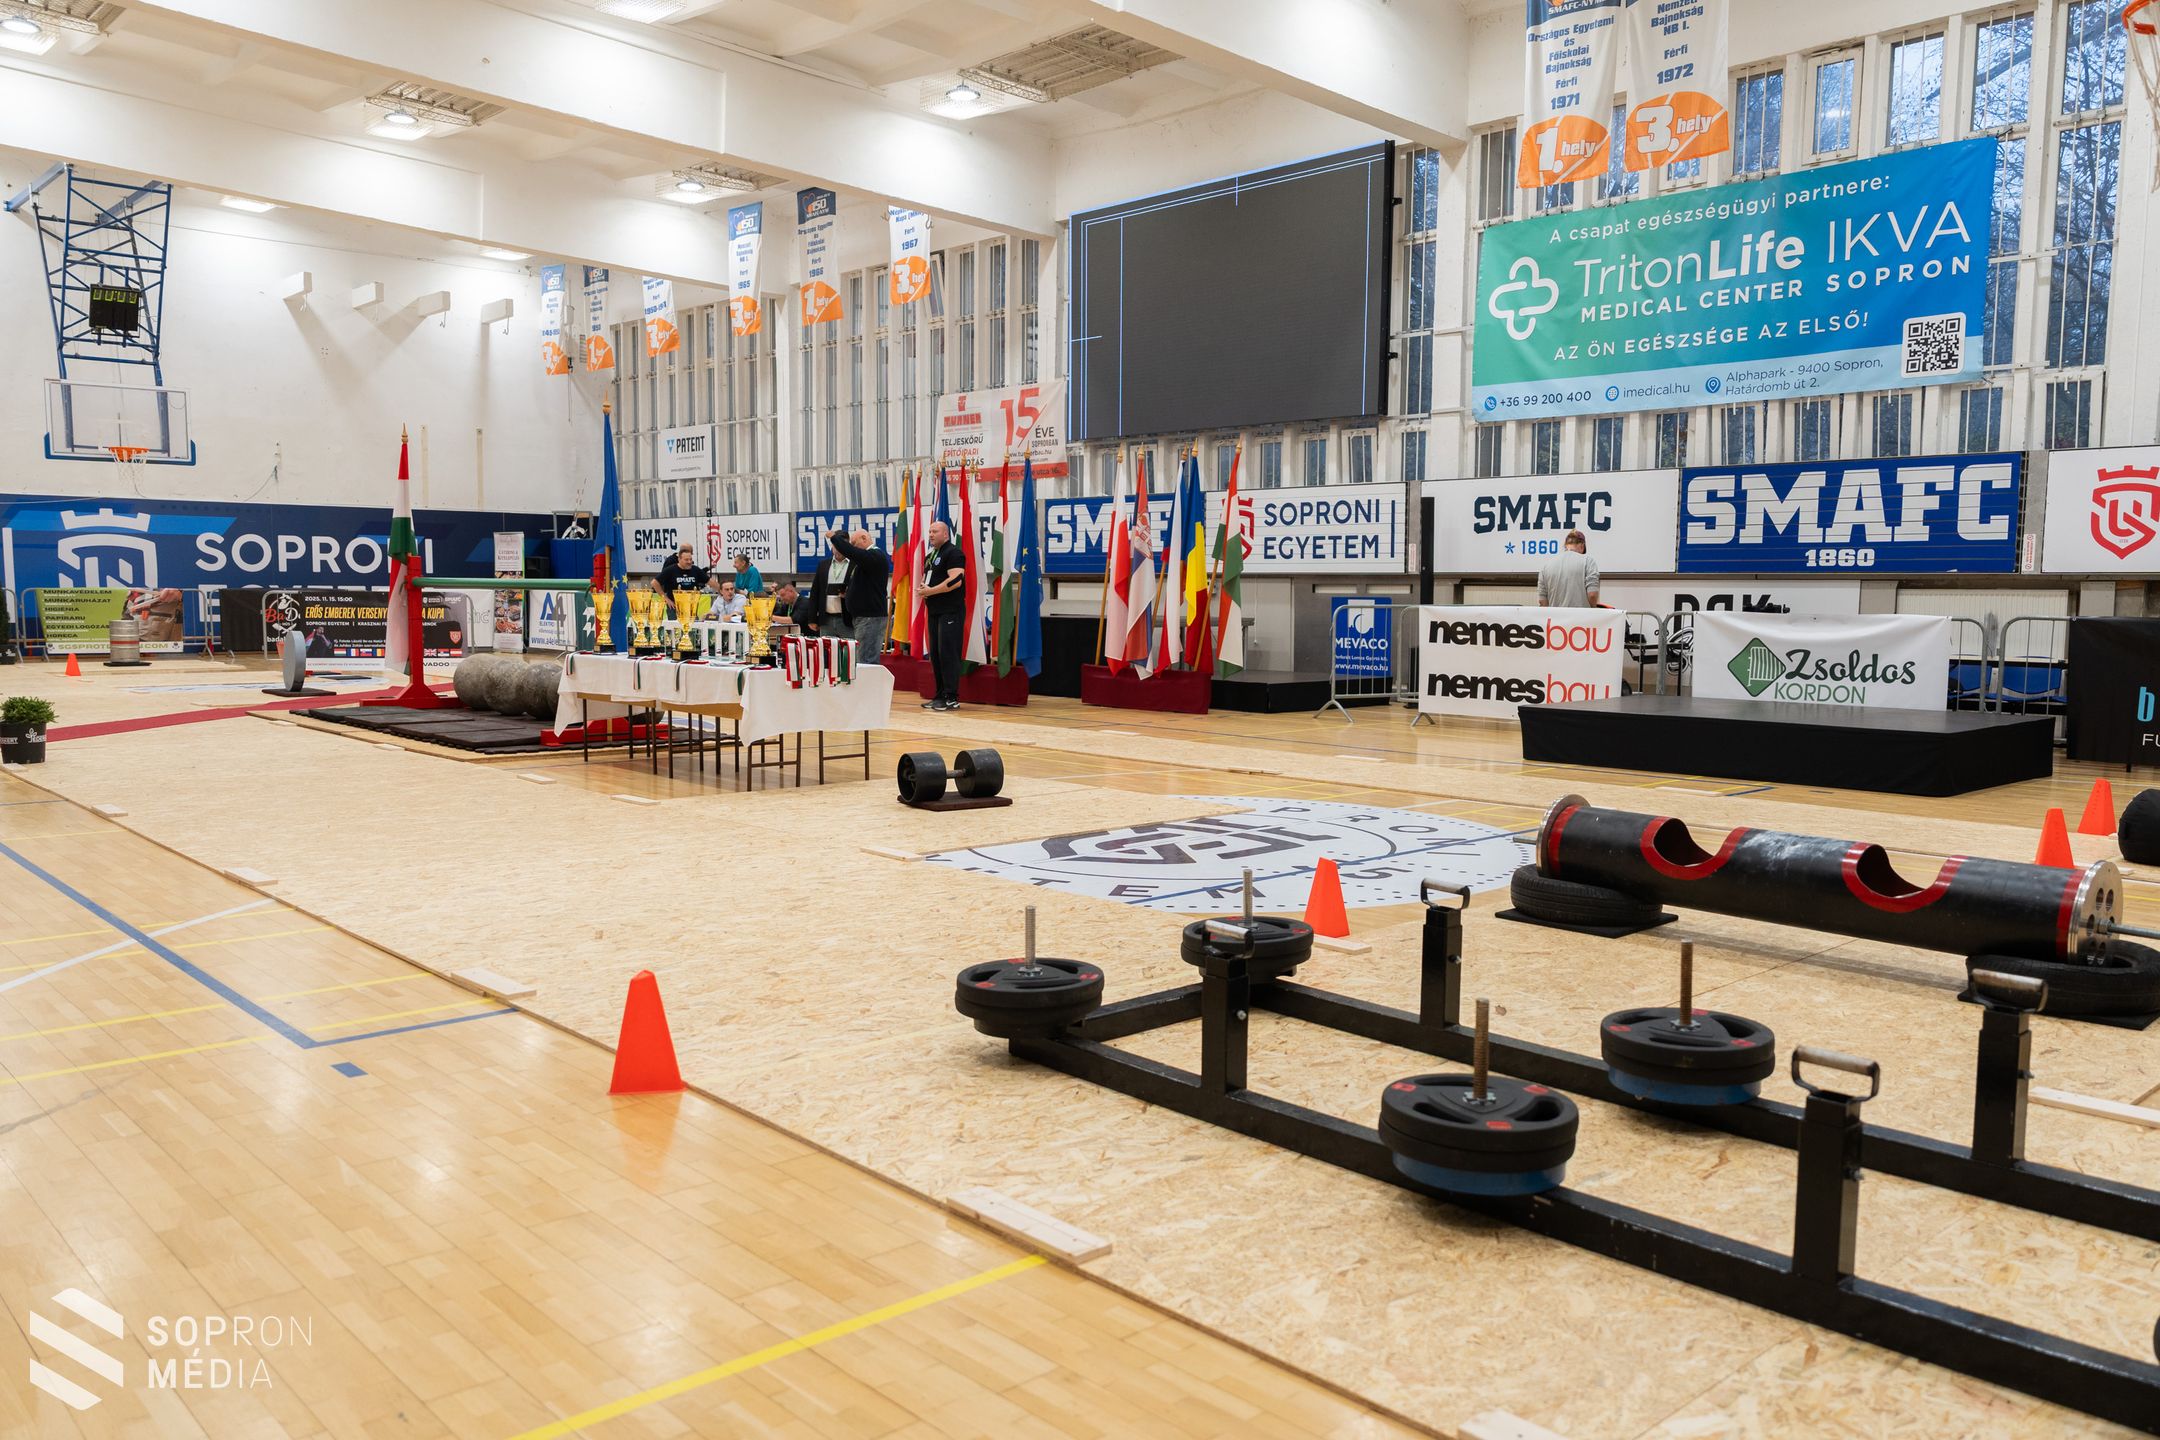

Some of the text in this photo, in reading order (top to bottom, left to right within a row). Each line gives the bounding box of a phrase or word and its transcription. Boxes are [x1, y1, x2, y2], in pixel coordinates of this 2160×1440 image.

[1651, 5, 1704, 28] Bajnokság
[1528, 15, 1615, 43] Országos Egyetemi
[1663, 20, 1690, 36] NB I.
[1564, 37, 1575, 47] és
[1664, 44, 1688, 60] Férfi
[1549, 45, 1589, 61] Főiskolai
[1546, 57, 1592, 74] Bajnokság
[1657, 63, 1693, 84] 1972
[1555, 76, 1578, 89] Férfi
[1551, 92, 1580, 109] 1971
[1636, 105, 1712, 153] 3. hely
[1536, 126, 1597, 173] 1. hely
[1550, 174, 1890, 243] A csapat egészségügyi partnere:
[901, 238, 919, 251] 1967
[1574, 201, 1971, 297] TritonLife IKVA
[894, 264, 915, 294] 3.
[1581, 255, 1970, 323] MEDICAL CENTER SOPRON
[1554, 310, 1869, 361] AZ ÖN EGÉSZSÉGE AZ ELSŐ!
[1726, 367, 1786, 383] Alphapark
[1797, 362, 1830, 376] 9400
[1834, 358, 1884, 373] Sopron,
[1623, 382, 1690, 399] imedical.hu
[1725, 377, 1820, 396] Határdomb út 2.
[1500, 390, 1592, 408] +36 99 200 400
[1000, 387, 1040, 446] 15
[1035, 426, 1055, 439] ÉVE
[676, 436, 705, 454] PATENT
[1264, 499, 1380, 527] SOPRONI
[1473, 491, 1612, 534] SMAFC
[1686, 462, 2012, 544] SMAFC
[635, 528, 678, 551] SMAFC
[727, 529, 770, 543] SOPRONI
[195, 532, 434, 574] SOPROI
[1263, 534, 1379, 560] EGYETEM
[1521, 540, 1558, 555] 1860
[1804, 548, 1875, 567] 1860
[650, 554, 663, 563] 1860
[305, 604, 323, 619] ERŐS
[324, 606, 356, 619] EMBEREK
[427, 607, 445, 620] KUPA
[1336, 637, 1389, 650] MEVACO
[1429, 618, 1613, 653] nemesbau
[1785, 649, 1916, 684] Zsoldos
[1774, 683, 1866, 704] KORDON
